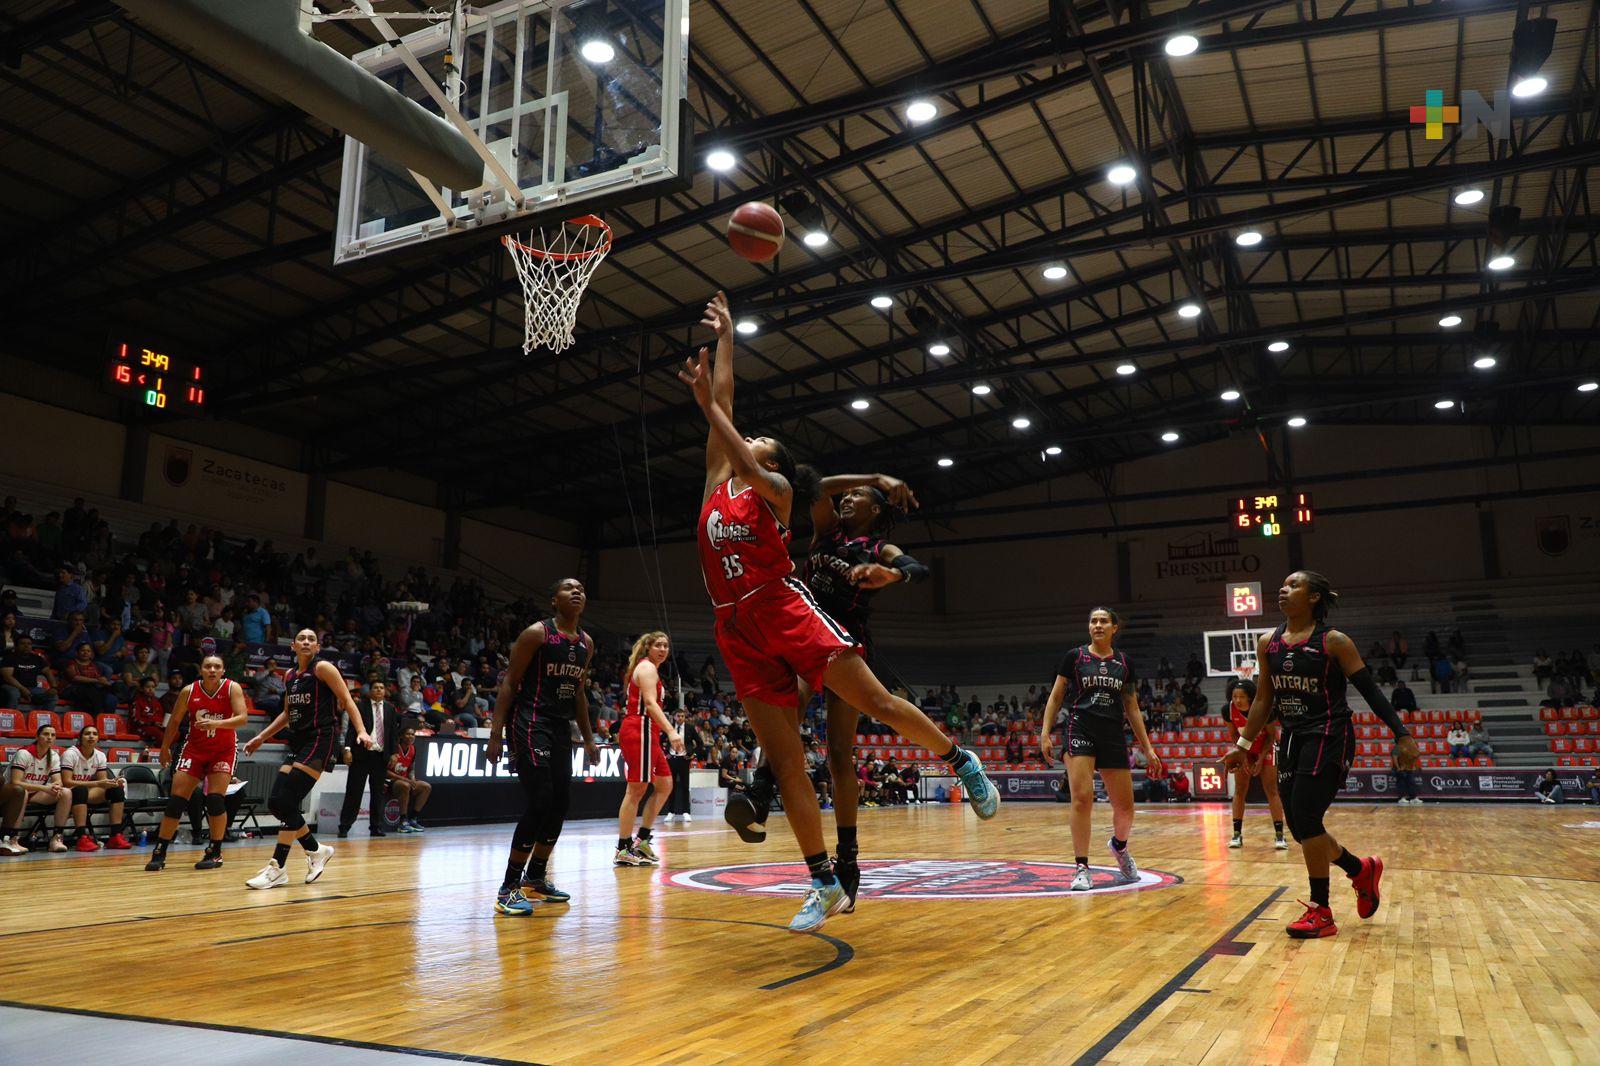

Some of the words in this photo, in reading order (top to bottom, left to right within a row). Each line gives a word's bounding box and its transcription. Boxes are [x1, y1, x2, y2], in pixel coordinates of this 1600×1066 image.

[121, 343, 128, 357] 1
[116, 365, 131, 384] 15
[194, 366, 201, 380] 1
[189, 387, 204, 405] 11
[203, 458, 286, 492] Zacatecas
[1238, 514, 1250, 527] 15
[1298, 510, 1311, 522] 11
[721, 554, 744, 580] 35
[1156, 554, 1261, 579] FRESNILLO
[546, 663, 585, 677] PLATERA
